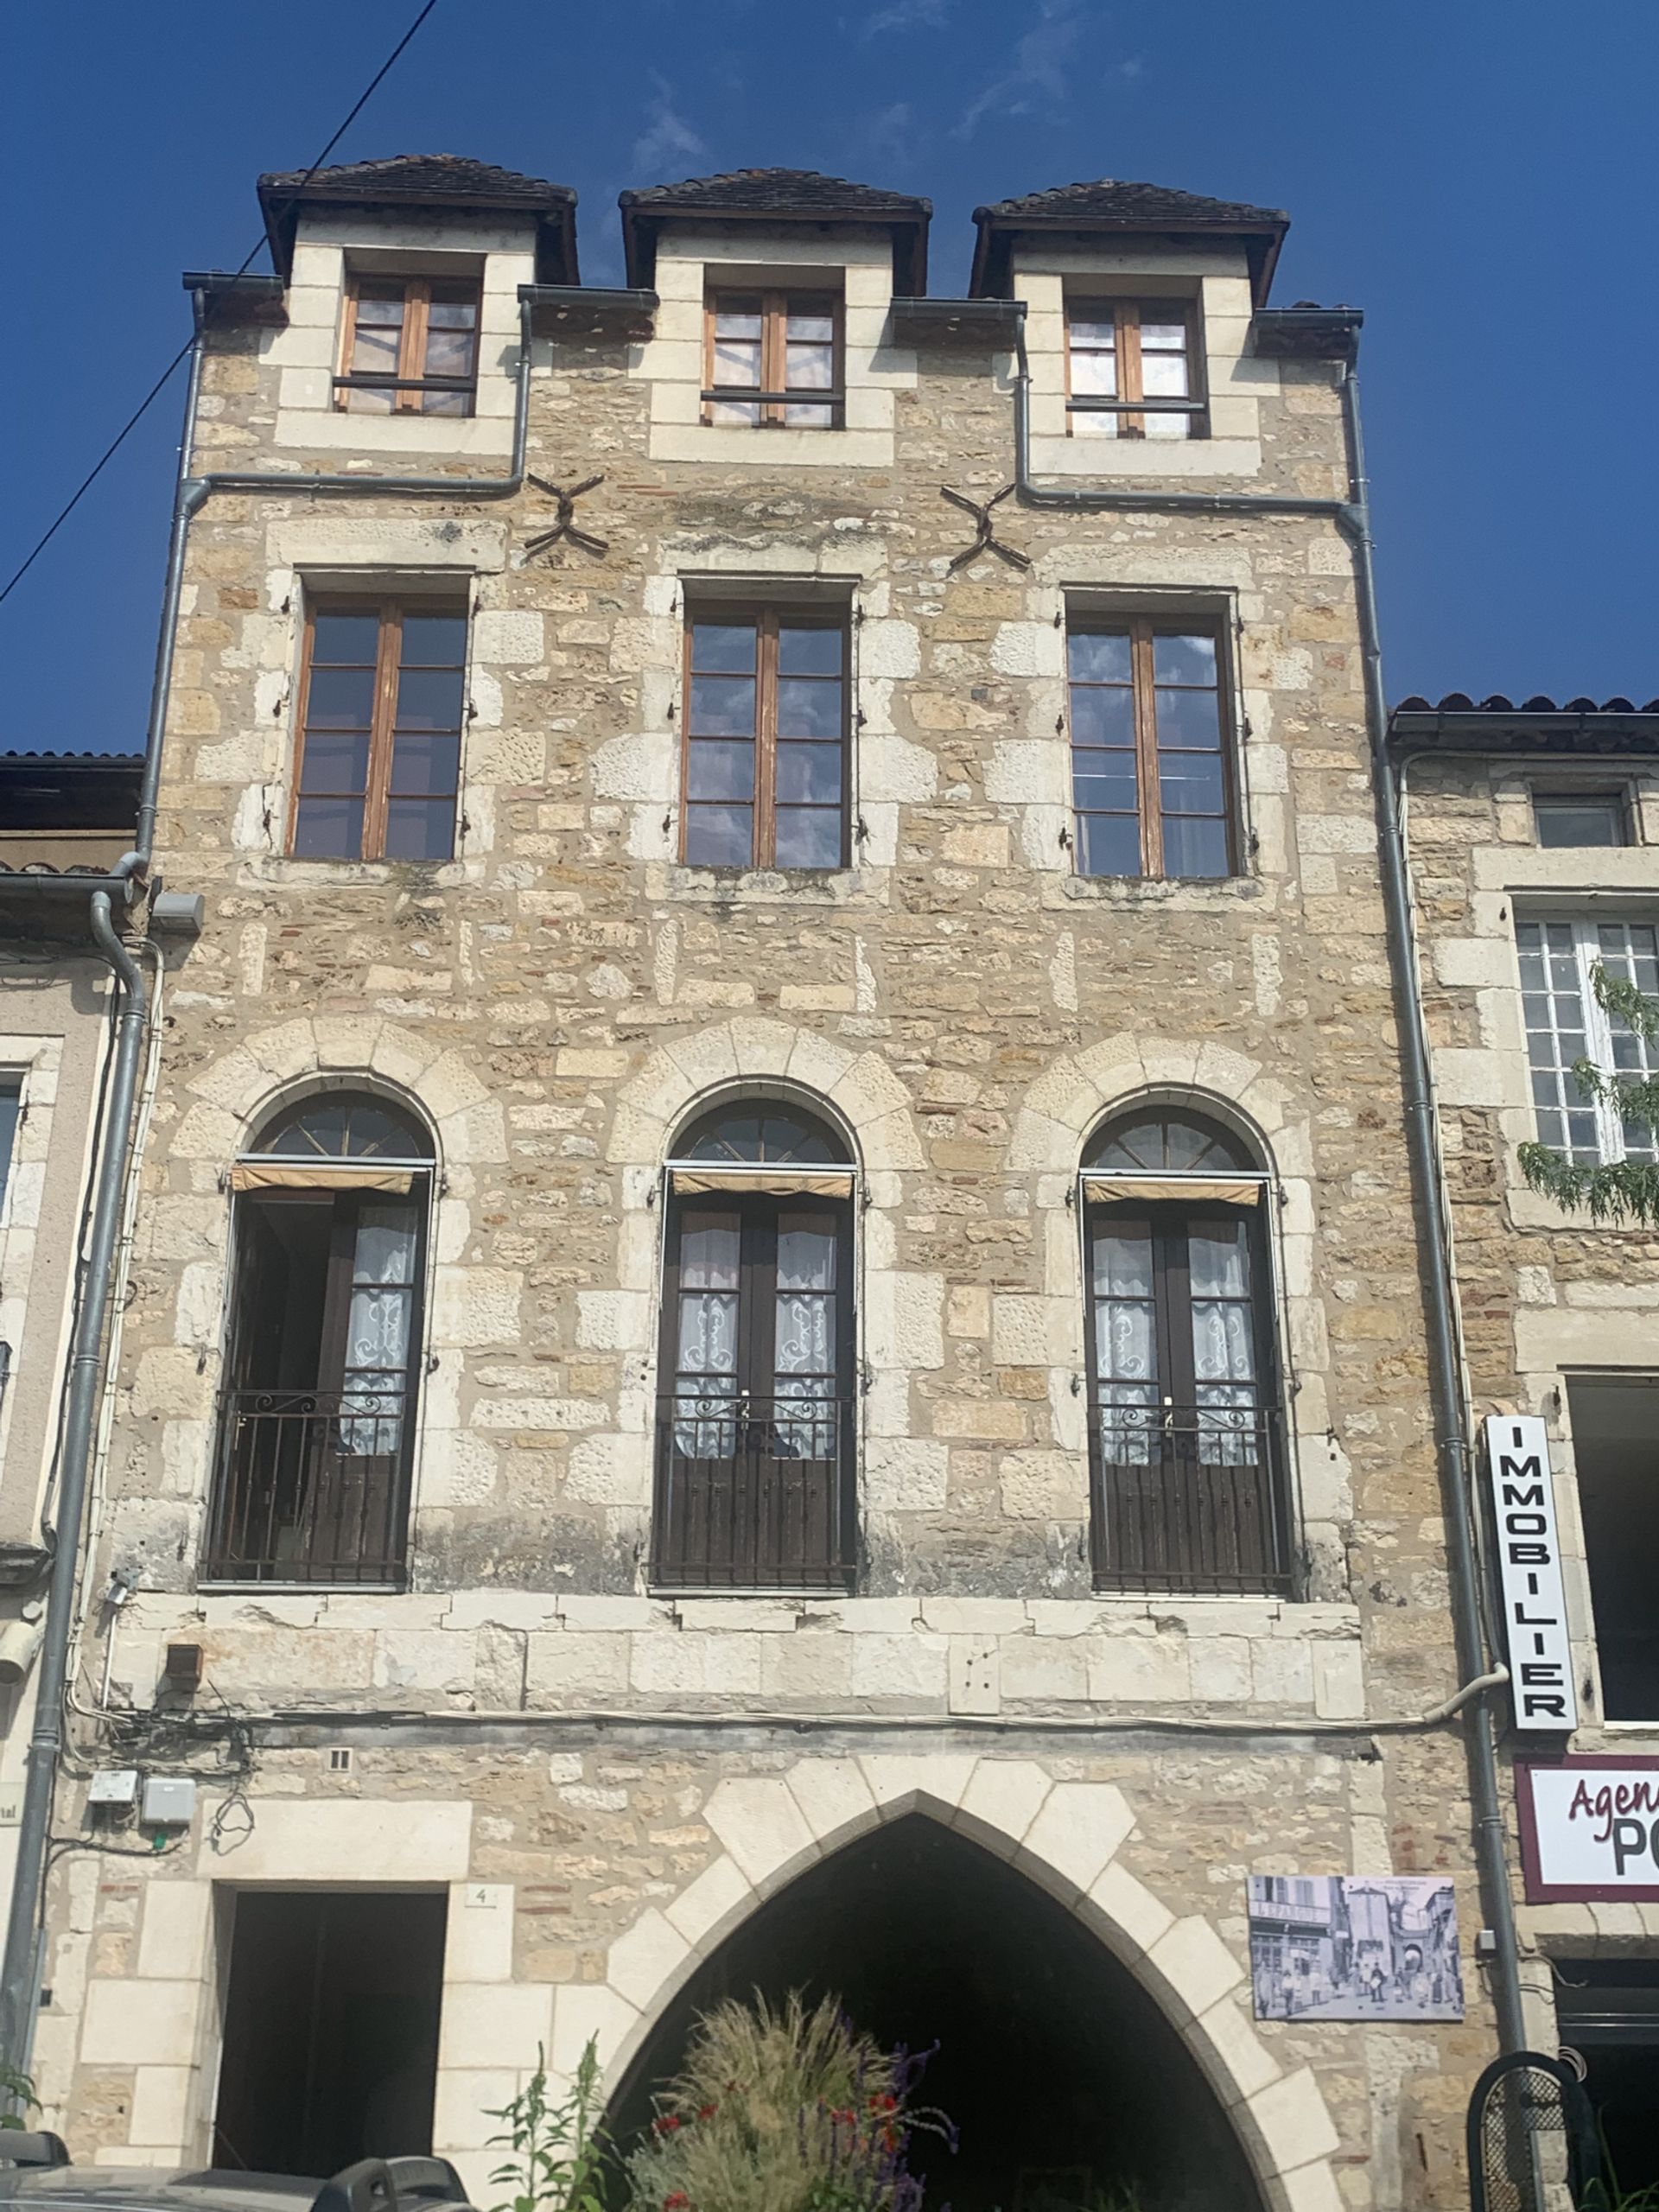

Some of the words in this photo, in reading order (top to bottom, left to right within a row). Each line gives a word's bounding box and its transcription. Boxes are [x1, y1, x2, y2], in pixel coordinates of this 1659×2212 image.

[1499, 1426, 1567, 1718] IMMOBILIER
[1568, 1778, 1659, 1843] Agen
[475, 1888, 486, 1904] 4
